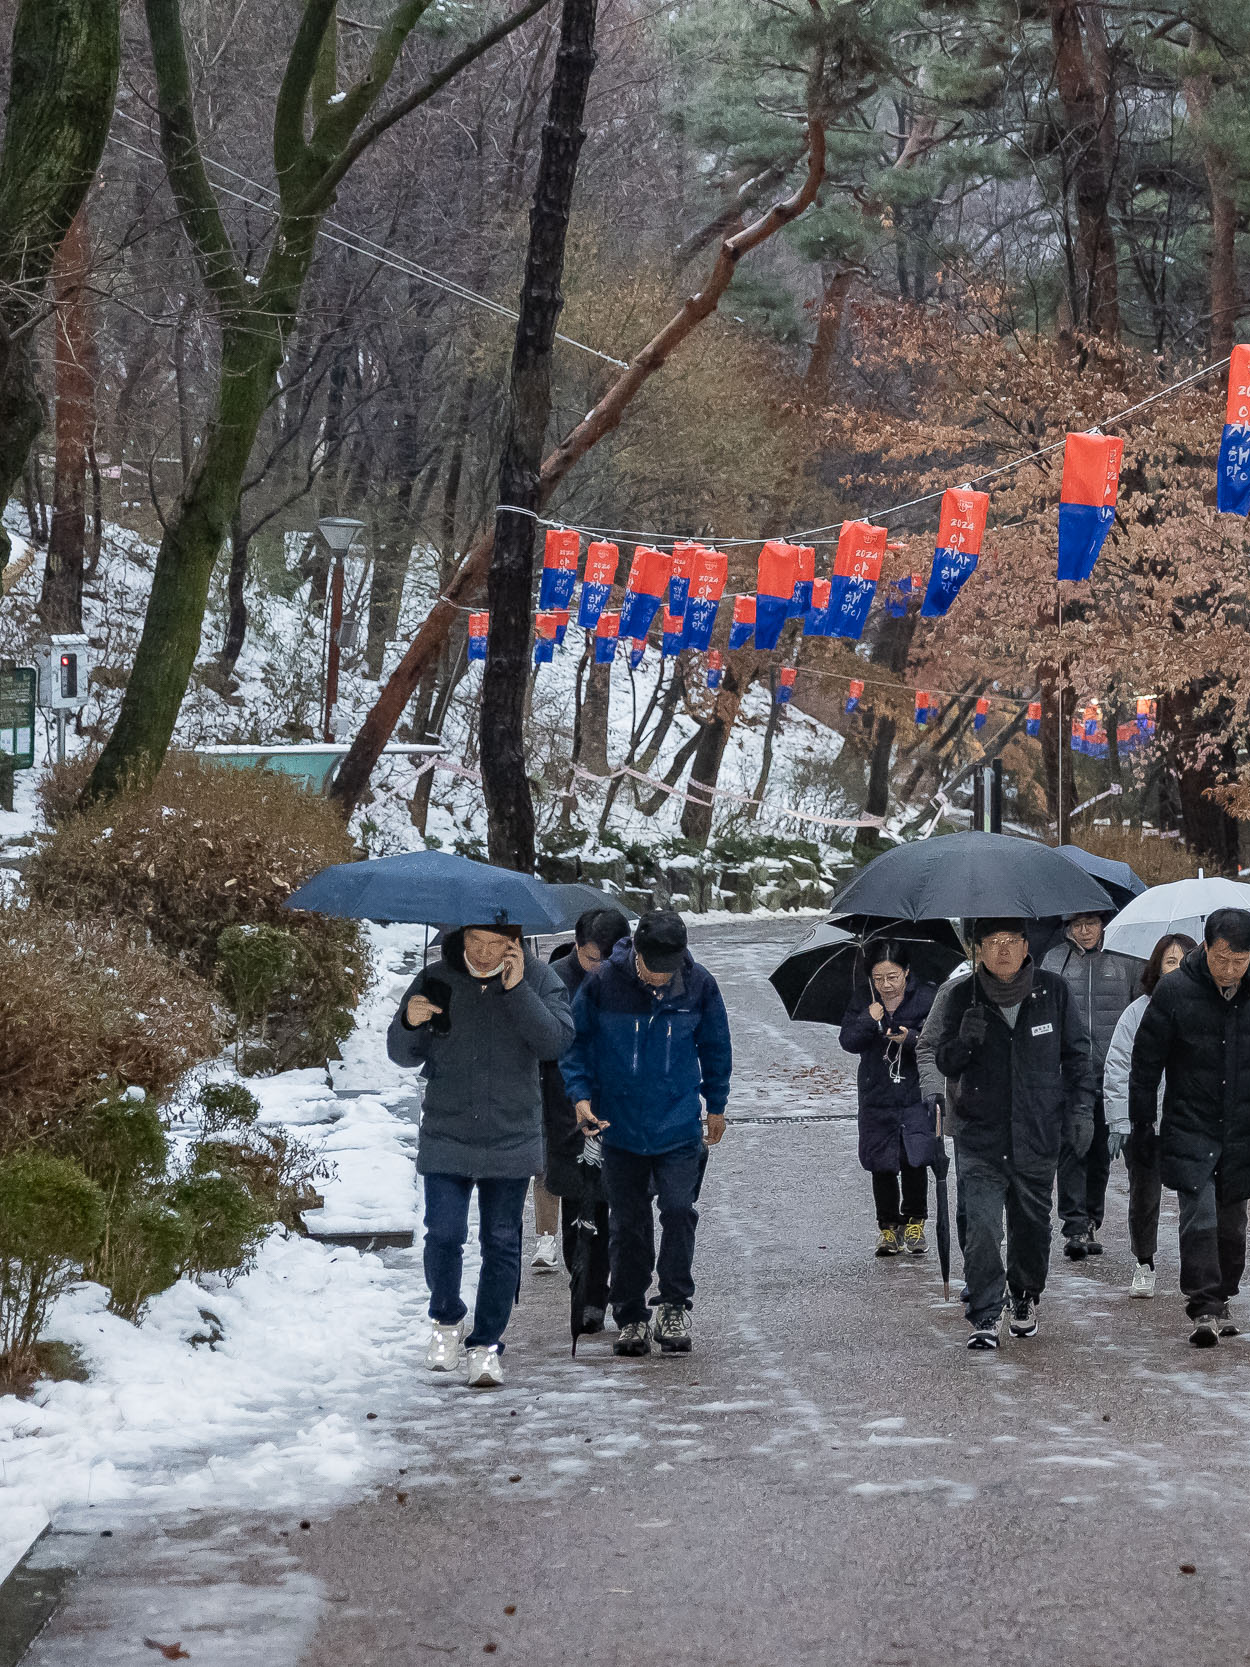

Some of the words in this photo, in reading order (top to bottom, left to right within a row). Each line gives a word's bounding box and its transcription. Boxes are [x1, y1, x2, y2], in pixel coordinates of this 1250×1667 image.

[950, 518, 975, 531] 2024
[855, 549, 878, 560] 2024
[942, 532, 970, 569] 아차산
[593, 562, 611, 570] 2024
[848, 561, 873, 594] 아차산
[588, 571, 609, 596] 아차산
[698, 575, 719, 583] 2024
[693, 585, 716, 612] 아차산
[841, 591, 862, 620] 해맞이
[692, 611, 709, 632] 해맞이
